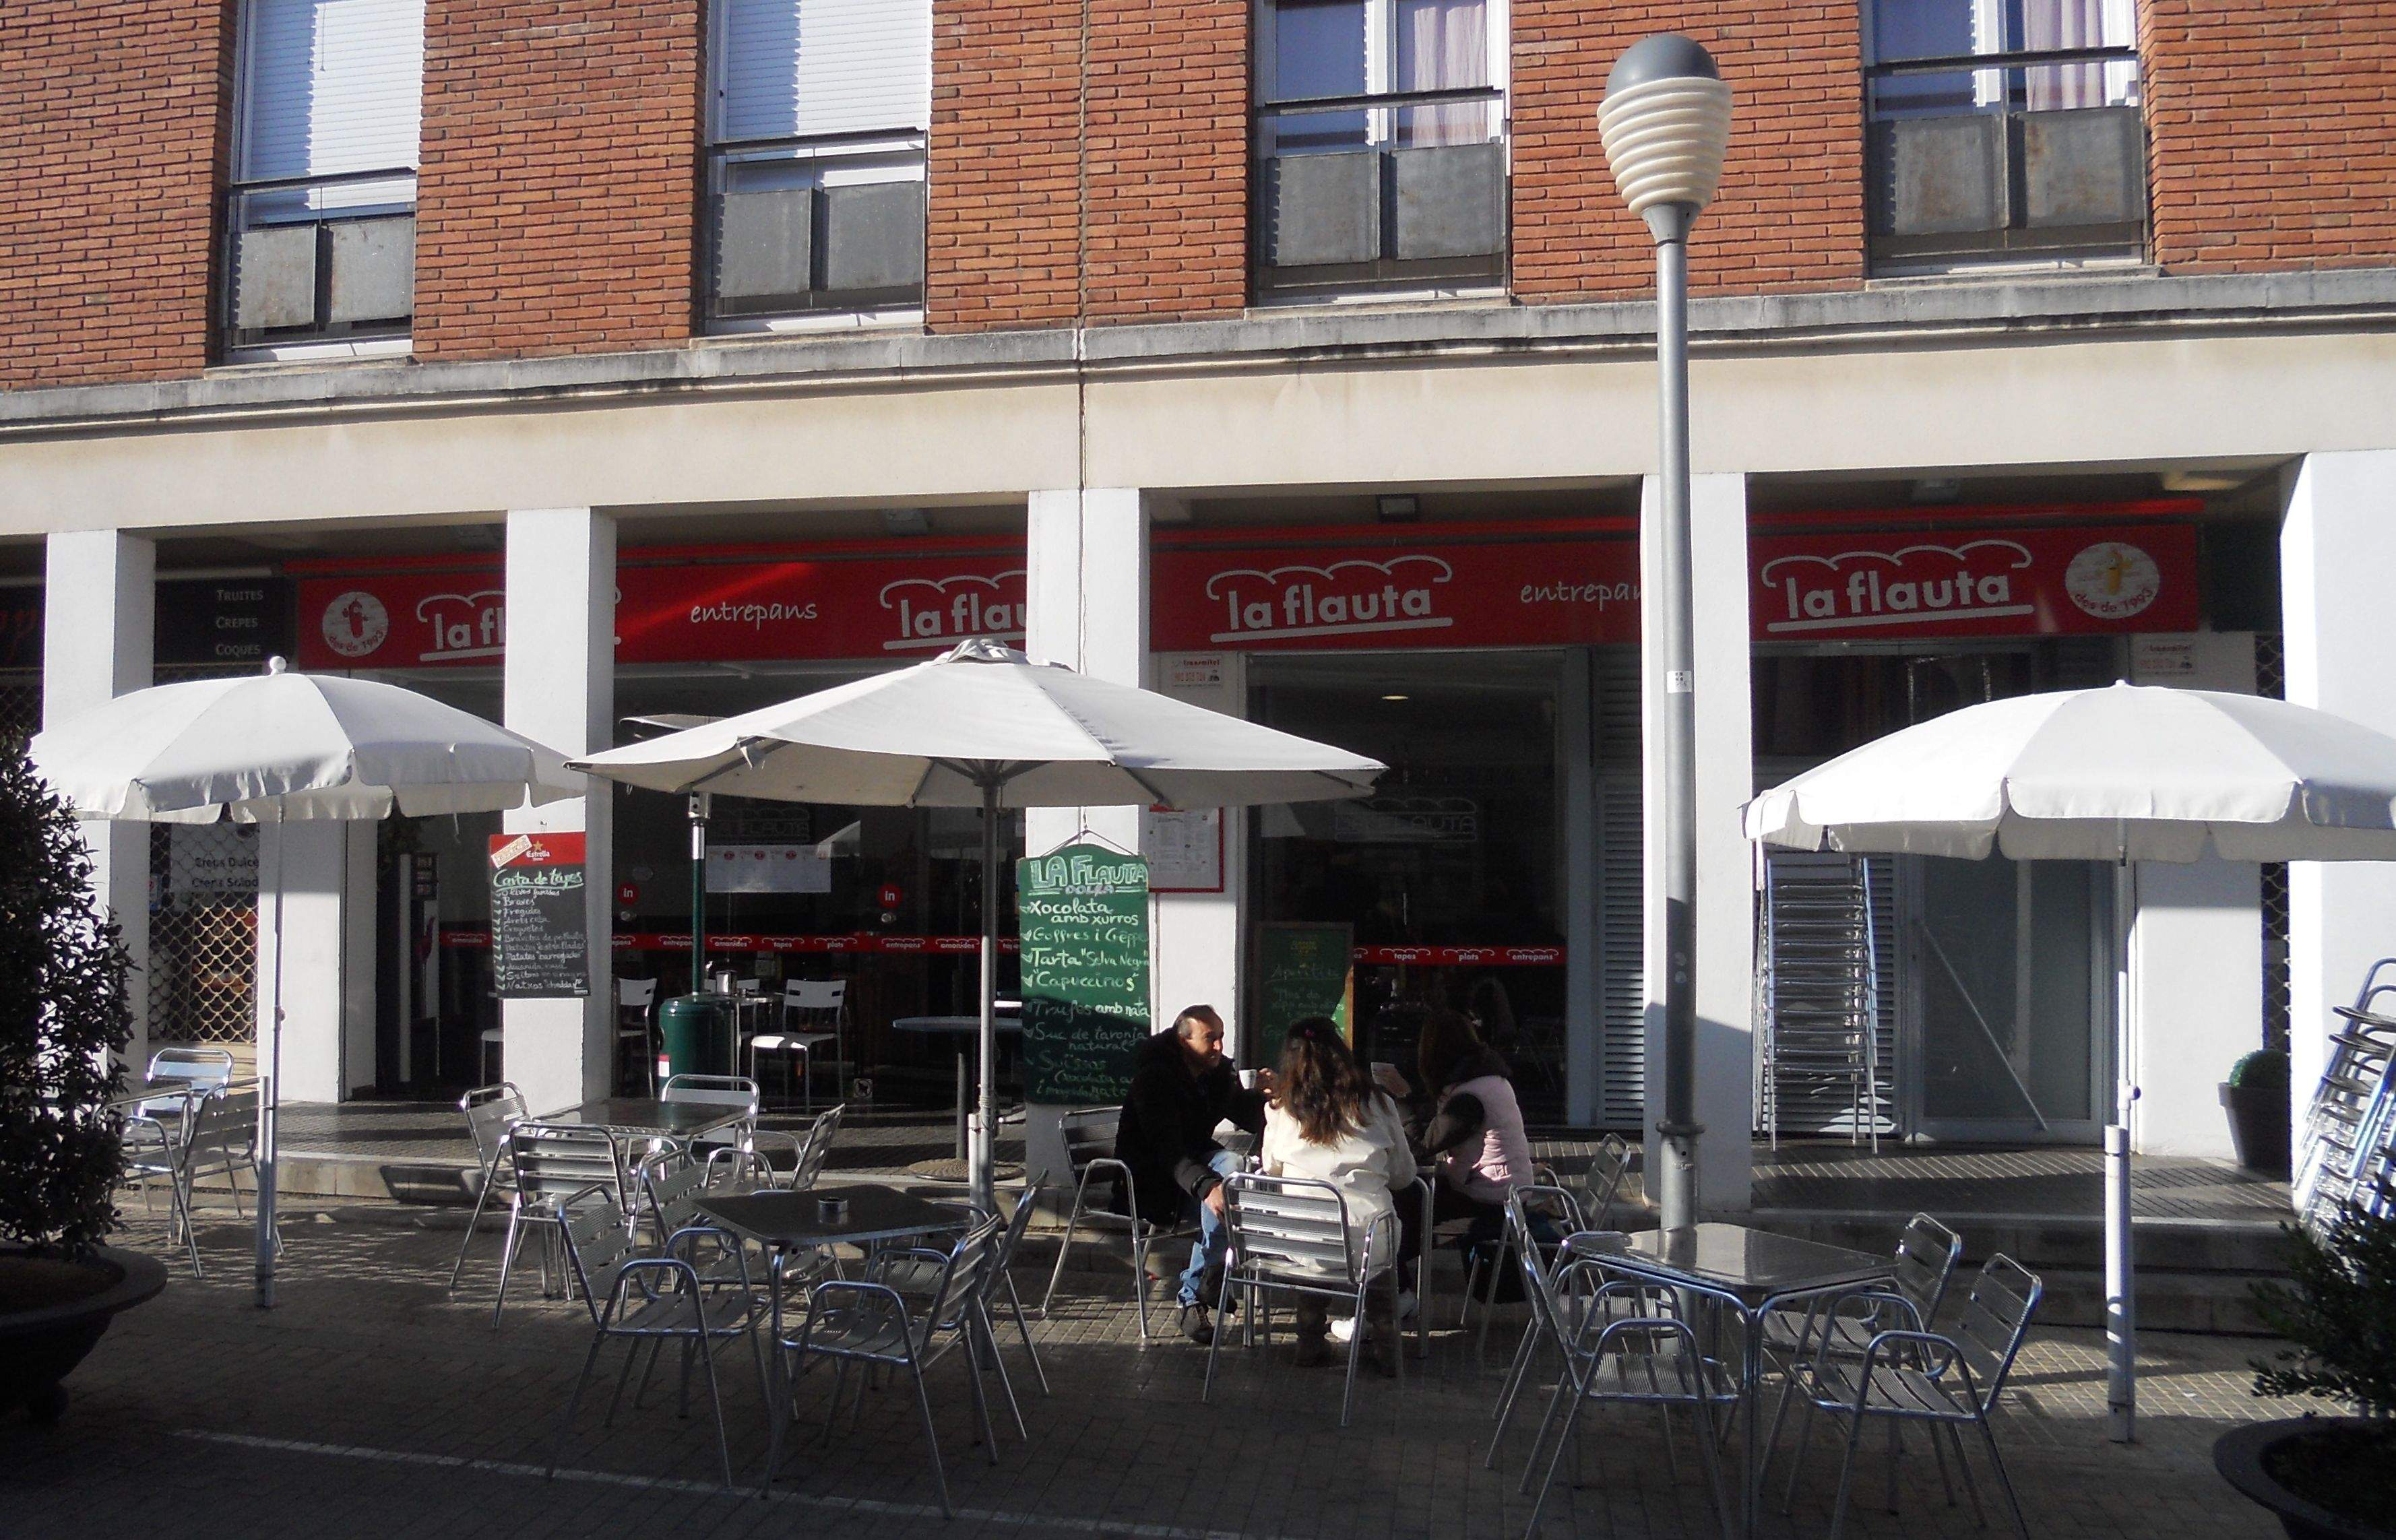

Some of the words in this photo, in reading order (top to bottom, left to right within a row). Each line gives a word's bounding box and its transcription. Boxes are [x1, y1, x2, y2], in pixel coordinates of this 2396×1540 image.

[1786, 577, 1835, 618] la
[1847, 569, 2010, 614] flauta
[691, 602, 818, 631] entrepans
[1228, 590, 1271, 630] la
[1283, 584, 1432, 625] flauta
[901, 599, 941, 638] la
[435, 613, 471, 649] la
[534, 871, 548, 885] de
[1030, 856, 1068, 889] LA
[1030, 897, 1114, 916] Xocolata
[1051, 913, 1089, 924] amb
[1092, 913, 1139, 926] xurros
[1030, 947, 1082, 968] Tarta
[1394, 953, 1416, 961] tapes
[1458, 953, 1479, 961] plats
[1512, 954, 1554, 962] entrepans
[1095, 1001, 1123, 1015] amb
[1125, 997, 1150, 1018] nata
[1071, 1028, 1090, 1040] de
